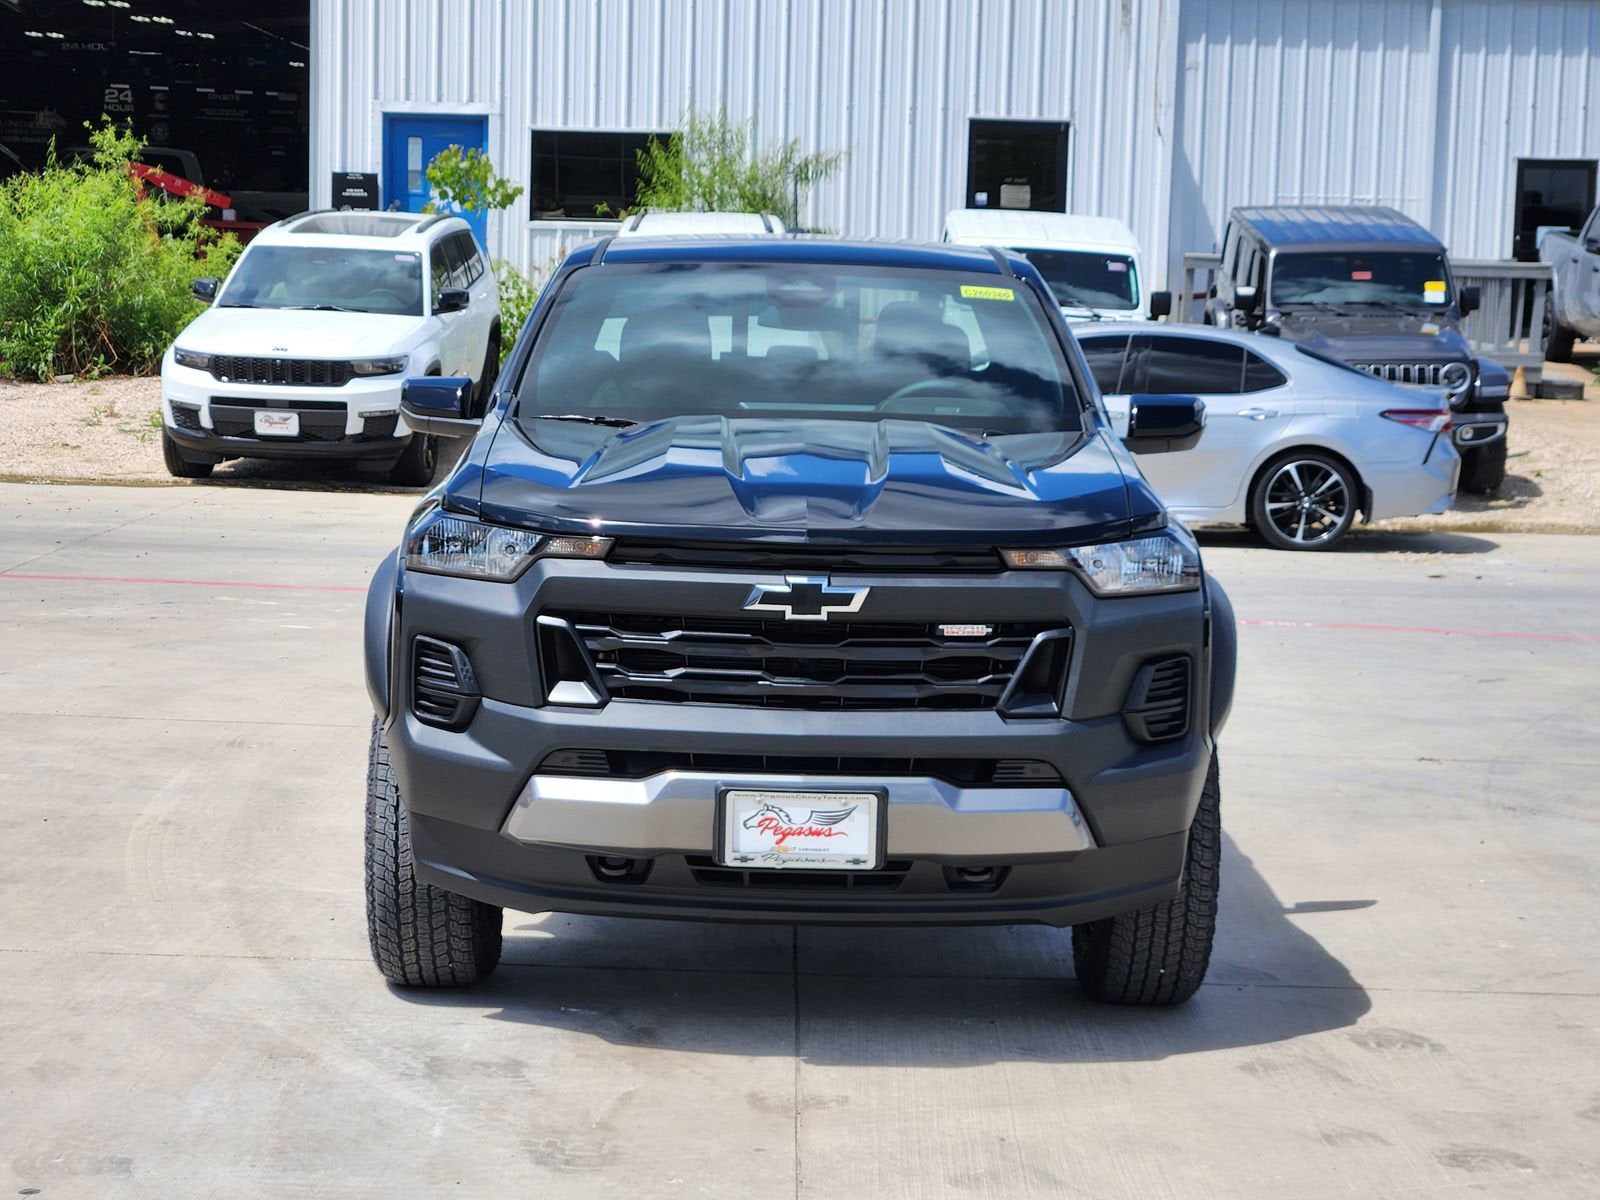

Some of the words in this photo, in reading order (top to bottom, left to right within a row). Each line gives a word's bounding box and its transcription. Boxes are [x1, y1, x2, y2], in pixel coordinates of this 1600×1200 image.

[104, 89, 133, 103] 24
[104, 104, 134, 112] HOUR
[758, 816, 848, 845] Pegasus
